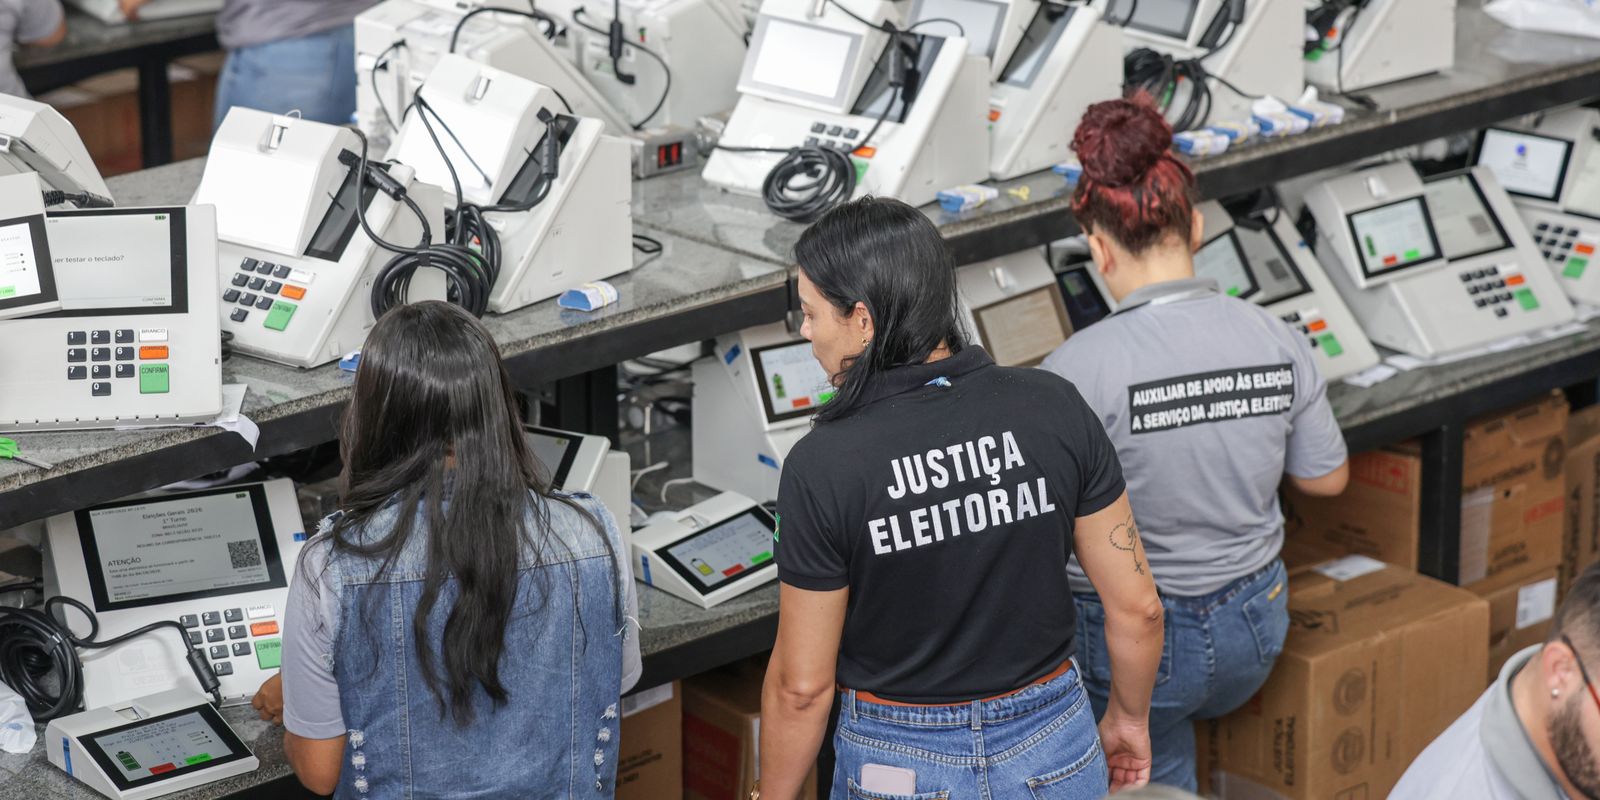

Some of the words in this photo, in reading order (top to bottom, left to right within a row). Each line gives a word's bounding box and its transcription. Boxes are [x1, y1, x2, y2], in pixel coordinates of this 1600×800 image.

[266, 280, 273, 288] 6
[241, 292, 247, 300] 8
[116, 330, 123, 338] 3
[117, 347, 123, 355] 6
[69, 366, 75, 374] 7
[93, 365, 99, 373] 8
[117, 364, 123, 372] 9
[93, 382, 100, 390] 0
[1132, 383, 1186, 407] AUXILIAR
[1187, 381, 1203, 397] DE
[1236, 372, 1252, 391] ÀS
[1132, 415, 1142, 430] A
[1143, 407, 1190, 427] SERVIÇO
[1191, 404, 1206, 421] DA
[887, 430, 1025, 499] JUSTIÇA
[867, 477, 1056, 555] ELEITORAL
[108, 557, 142, 567] ATENÇÃO
[226, 609, 233, 618] 3
[207, 629, 214, 637] 5
[230, 626, 237, 634] 6
[211, 646, 218, 654] 8
[234, 643, 241, 651] 9
[216, 663, 222, 671] 0
